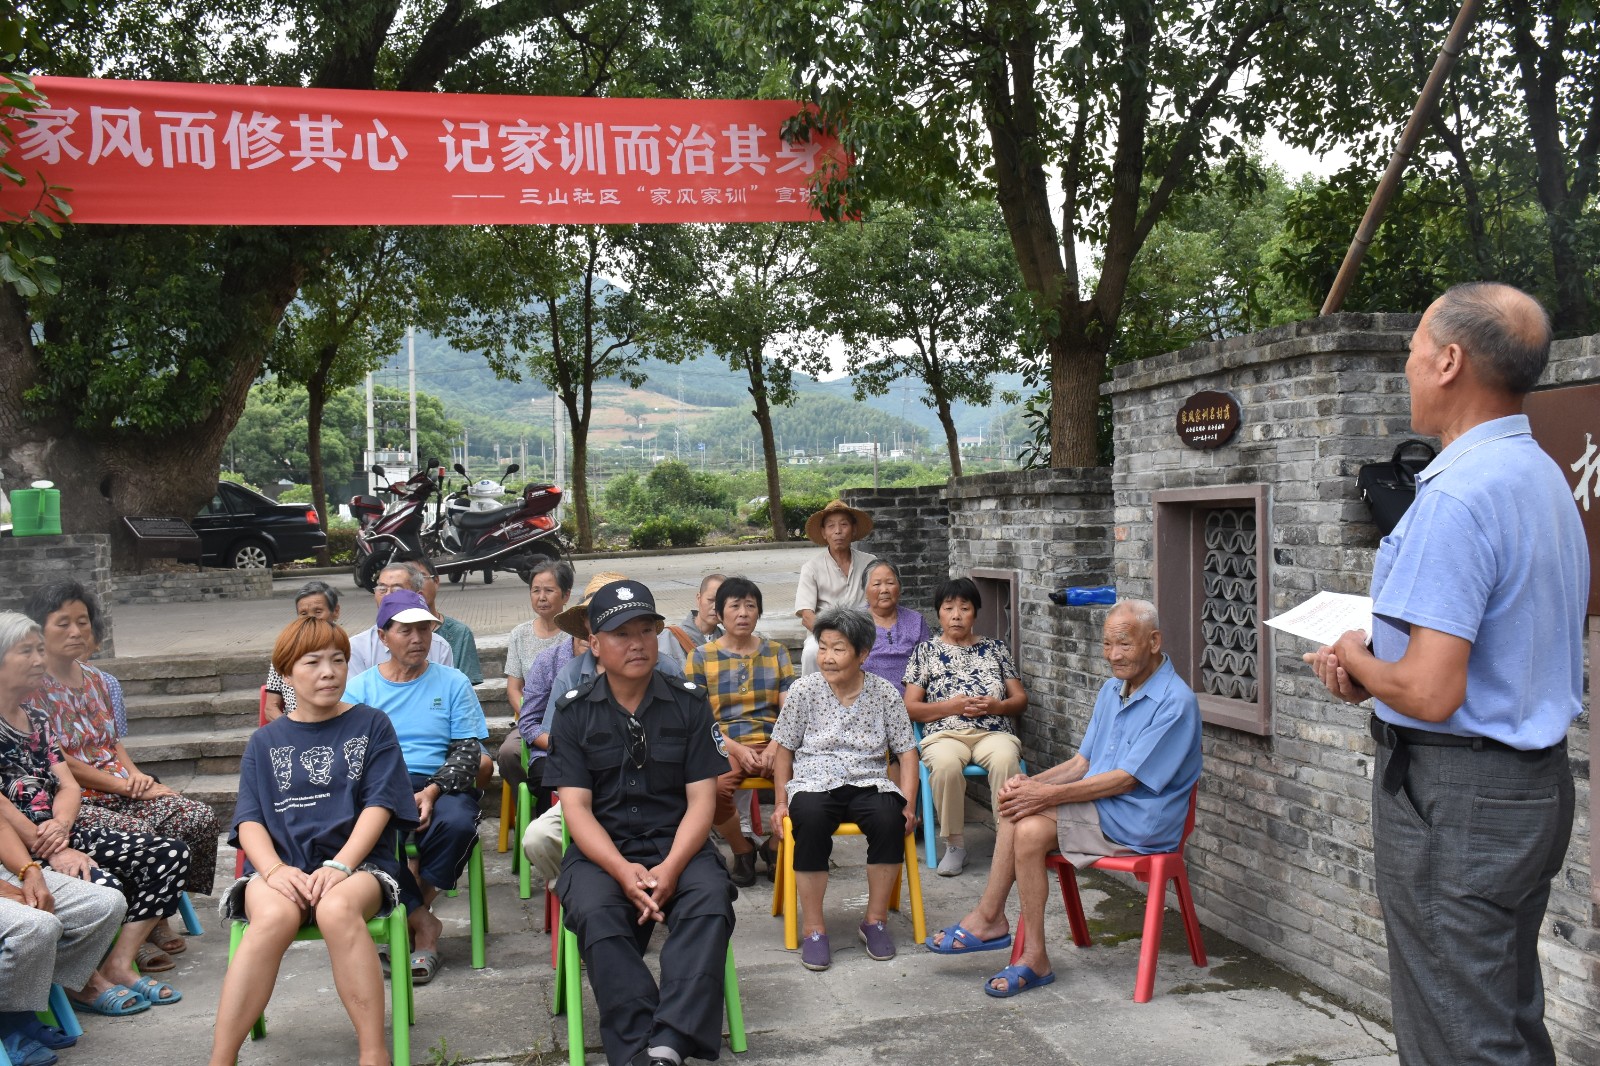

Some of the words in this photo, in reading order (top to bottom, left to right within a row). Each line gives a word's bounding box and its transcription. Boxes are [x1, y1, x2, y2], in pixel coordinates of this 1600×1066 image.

[0, 105, 408, 173] 家风而修其心
[438, 118, 822, 175] 记家训而治其身
